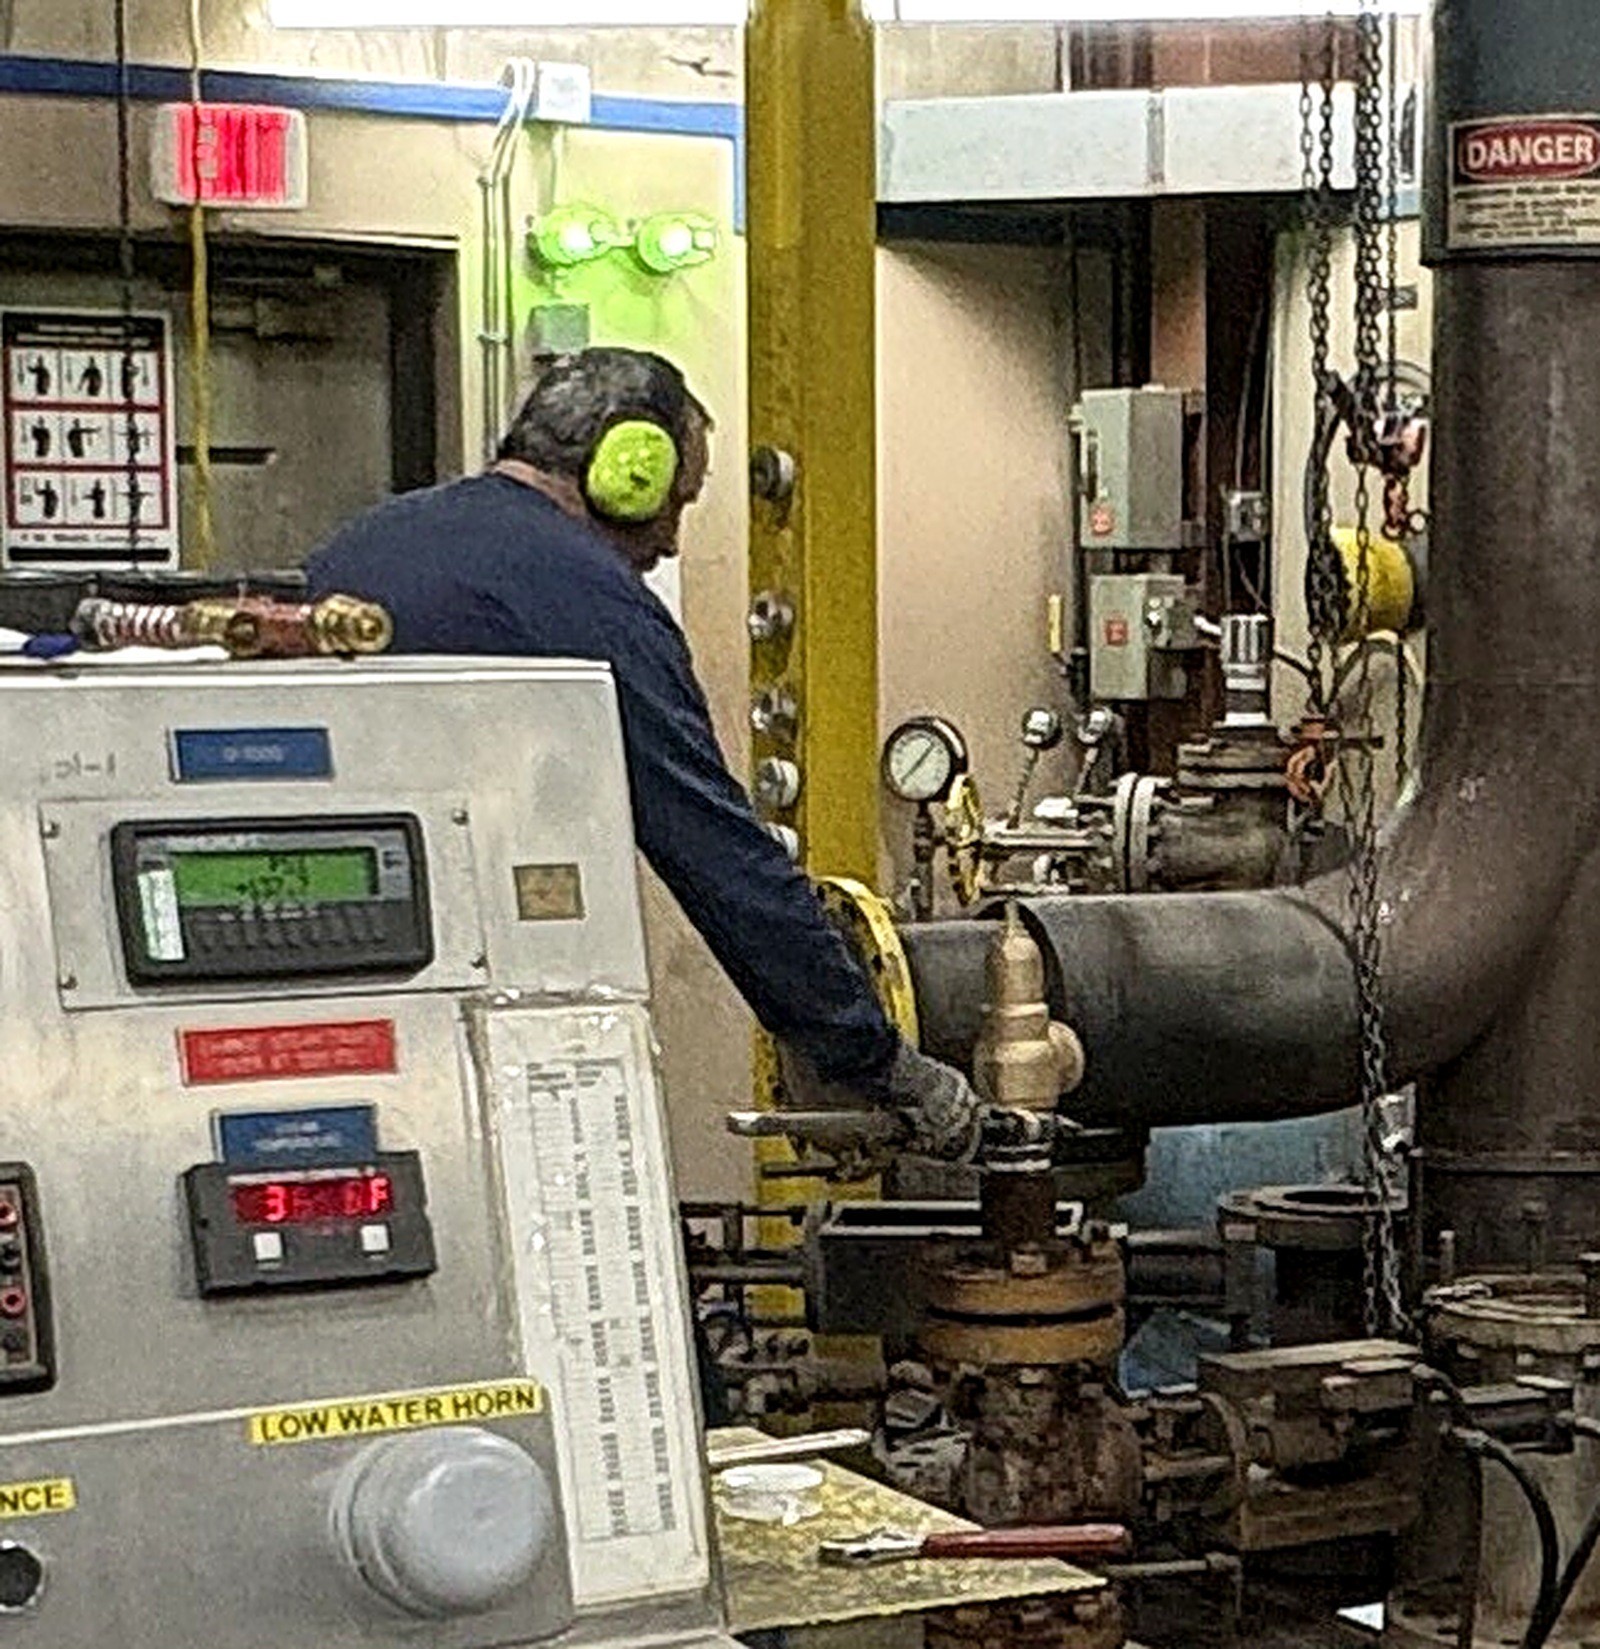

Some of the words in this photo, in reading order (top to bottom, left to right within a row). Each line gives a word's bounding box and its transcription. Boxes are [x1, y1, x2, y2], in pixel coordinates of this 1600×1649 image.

[1466, 134, 1594, 170] DANGER
[260, 1411, 329, 1441] LOW
[338, 1399, 443, 1431] WATER
[451, 1386, 535, 1417] HORN
[0, 1485, 65, 1511] NCE
